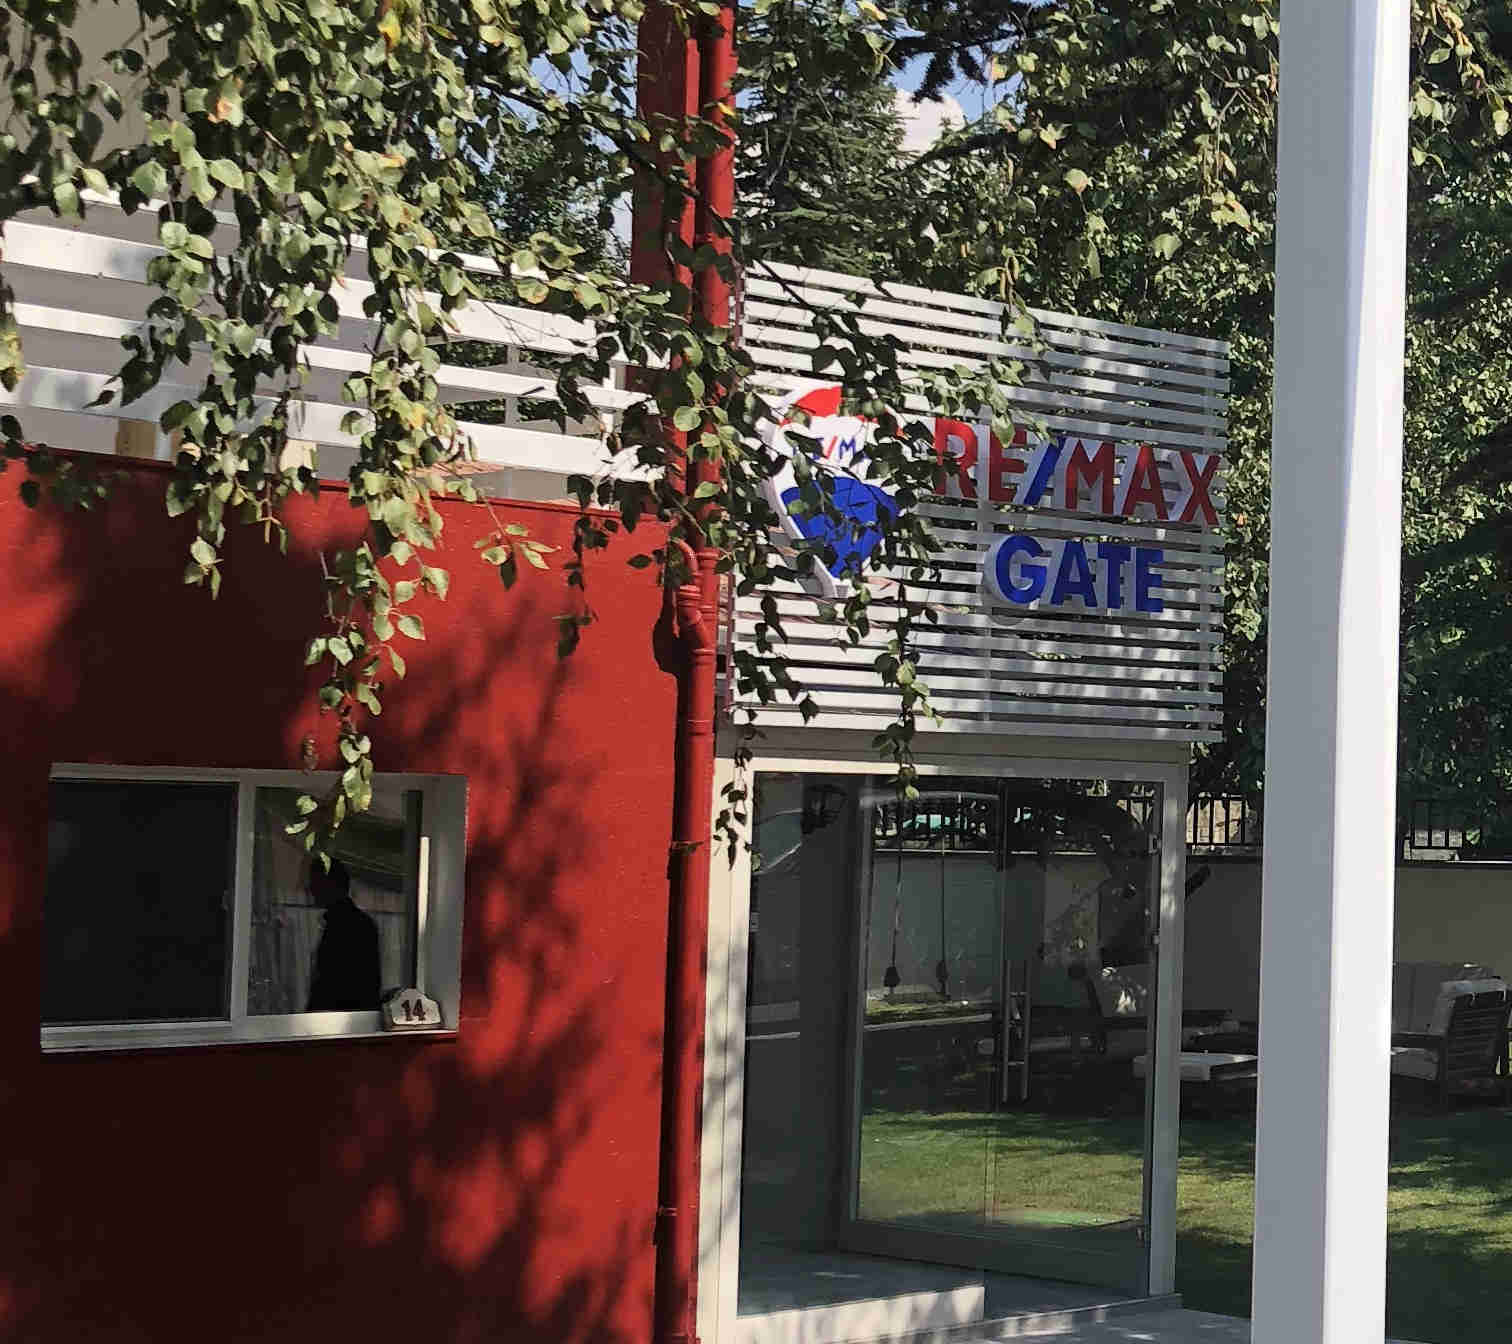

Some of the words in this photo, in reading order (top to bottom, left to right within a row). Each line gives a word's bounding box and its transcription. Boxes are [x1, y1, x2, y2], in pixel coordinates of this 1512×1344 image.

[933, 416, 1222, 527] RE/MAX
[995, 534, 1165, 614] GATE
[401, 998, 426, 1022] 14
